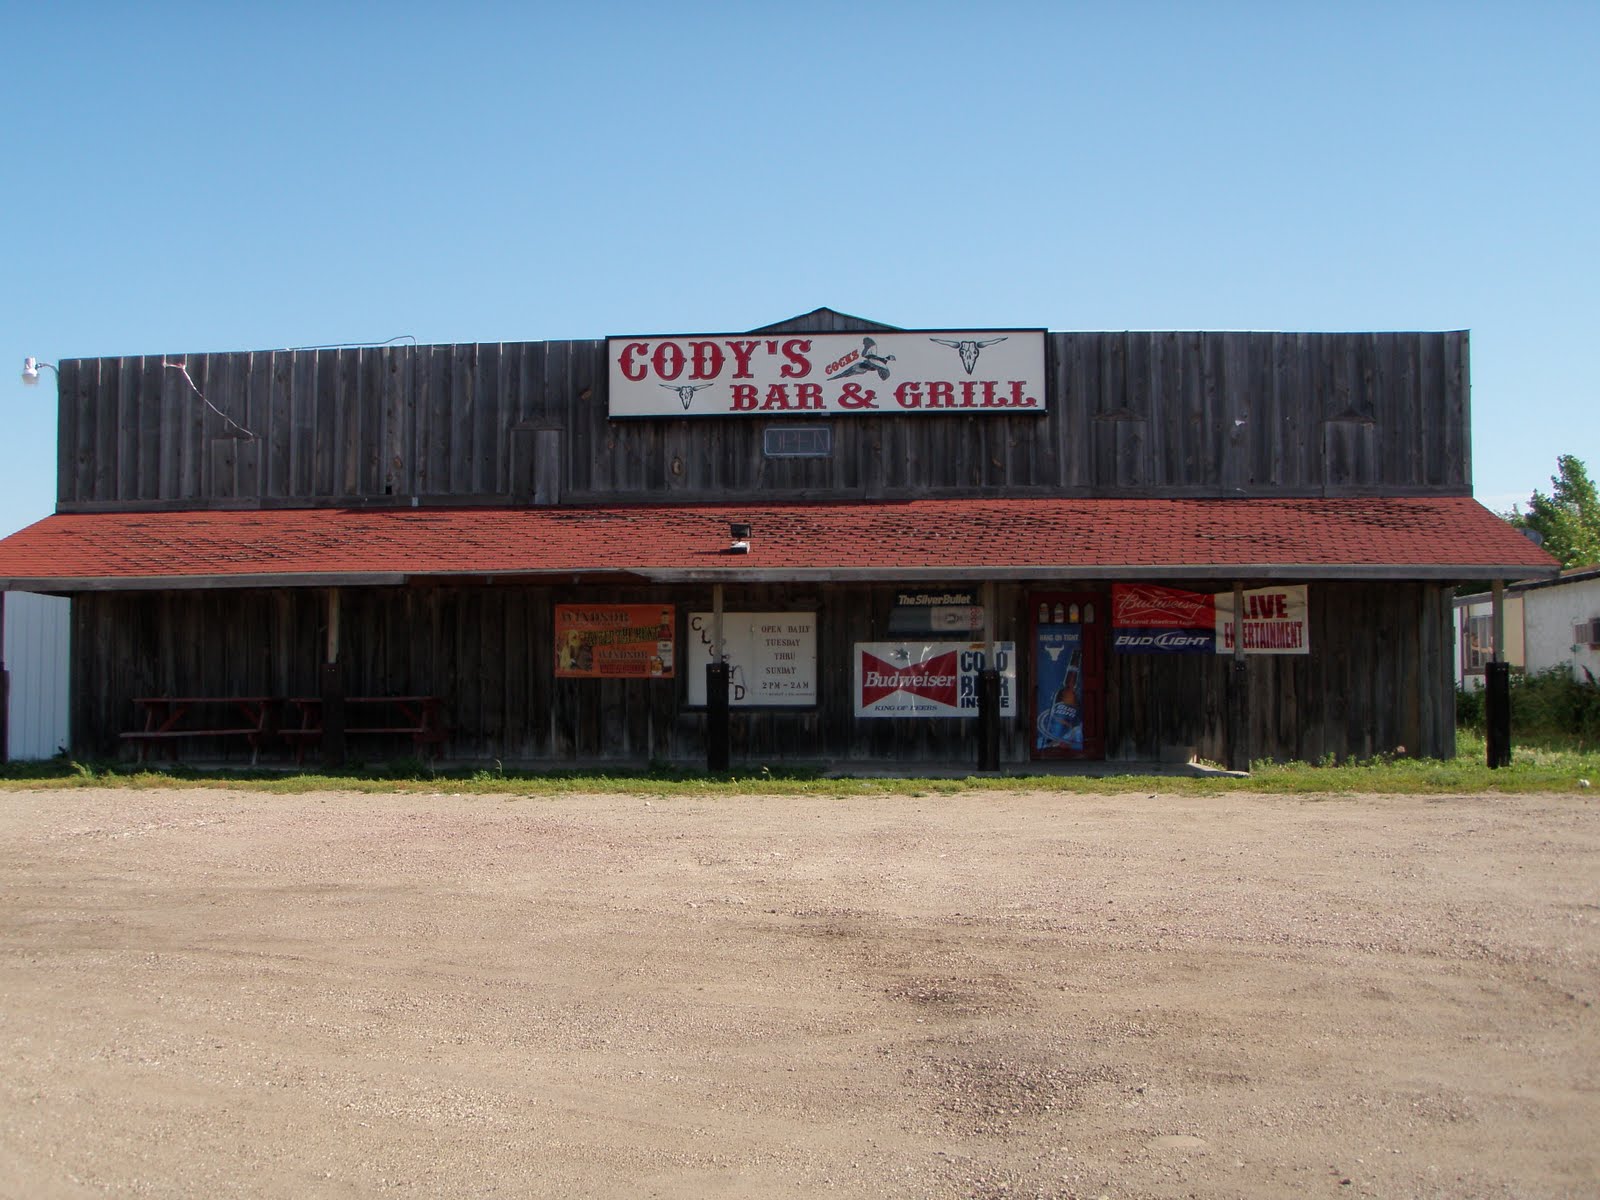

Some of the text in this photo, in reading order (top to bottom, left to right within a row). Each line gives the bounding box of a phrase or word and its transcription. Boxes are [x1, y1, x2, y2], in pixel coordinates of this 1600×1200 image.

[617, 338, 813, 382] CODY'S
[730, 380, 1038, 411] BAR & GRILL
[898, 594, 971, 605] The Silver Bullet
[1117, 593, 1206, 610] Budweiser
[1242, 594, 1289, 619] LIVE
[761, 625, 811, 633] OPEN DAILY
[1224, 621, 1303, 649] ENERTAINMENT
[765, 638, 801, 647] TUESDAY
[1114, 635, 1211, 646] BUD LIGHT
[774, 652, 796, 660] THRU
[960, 650, 1009, 673] COD
[765, 667, 797, 675] SUNDAY
[864, 670, 957, 688] Budweiser
